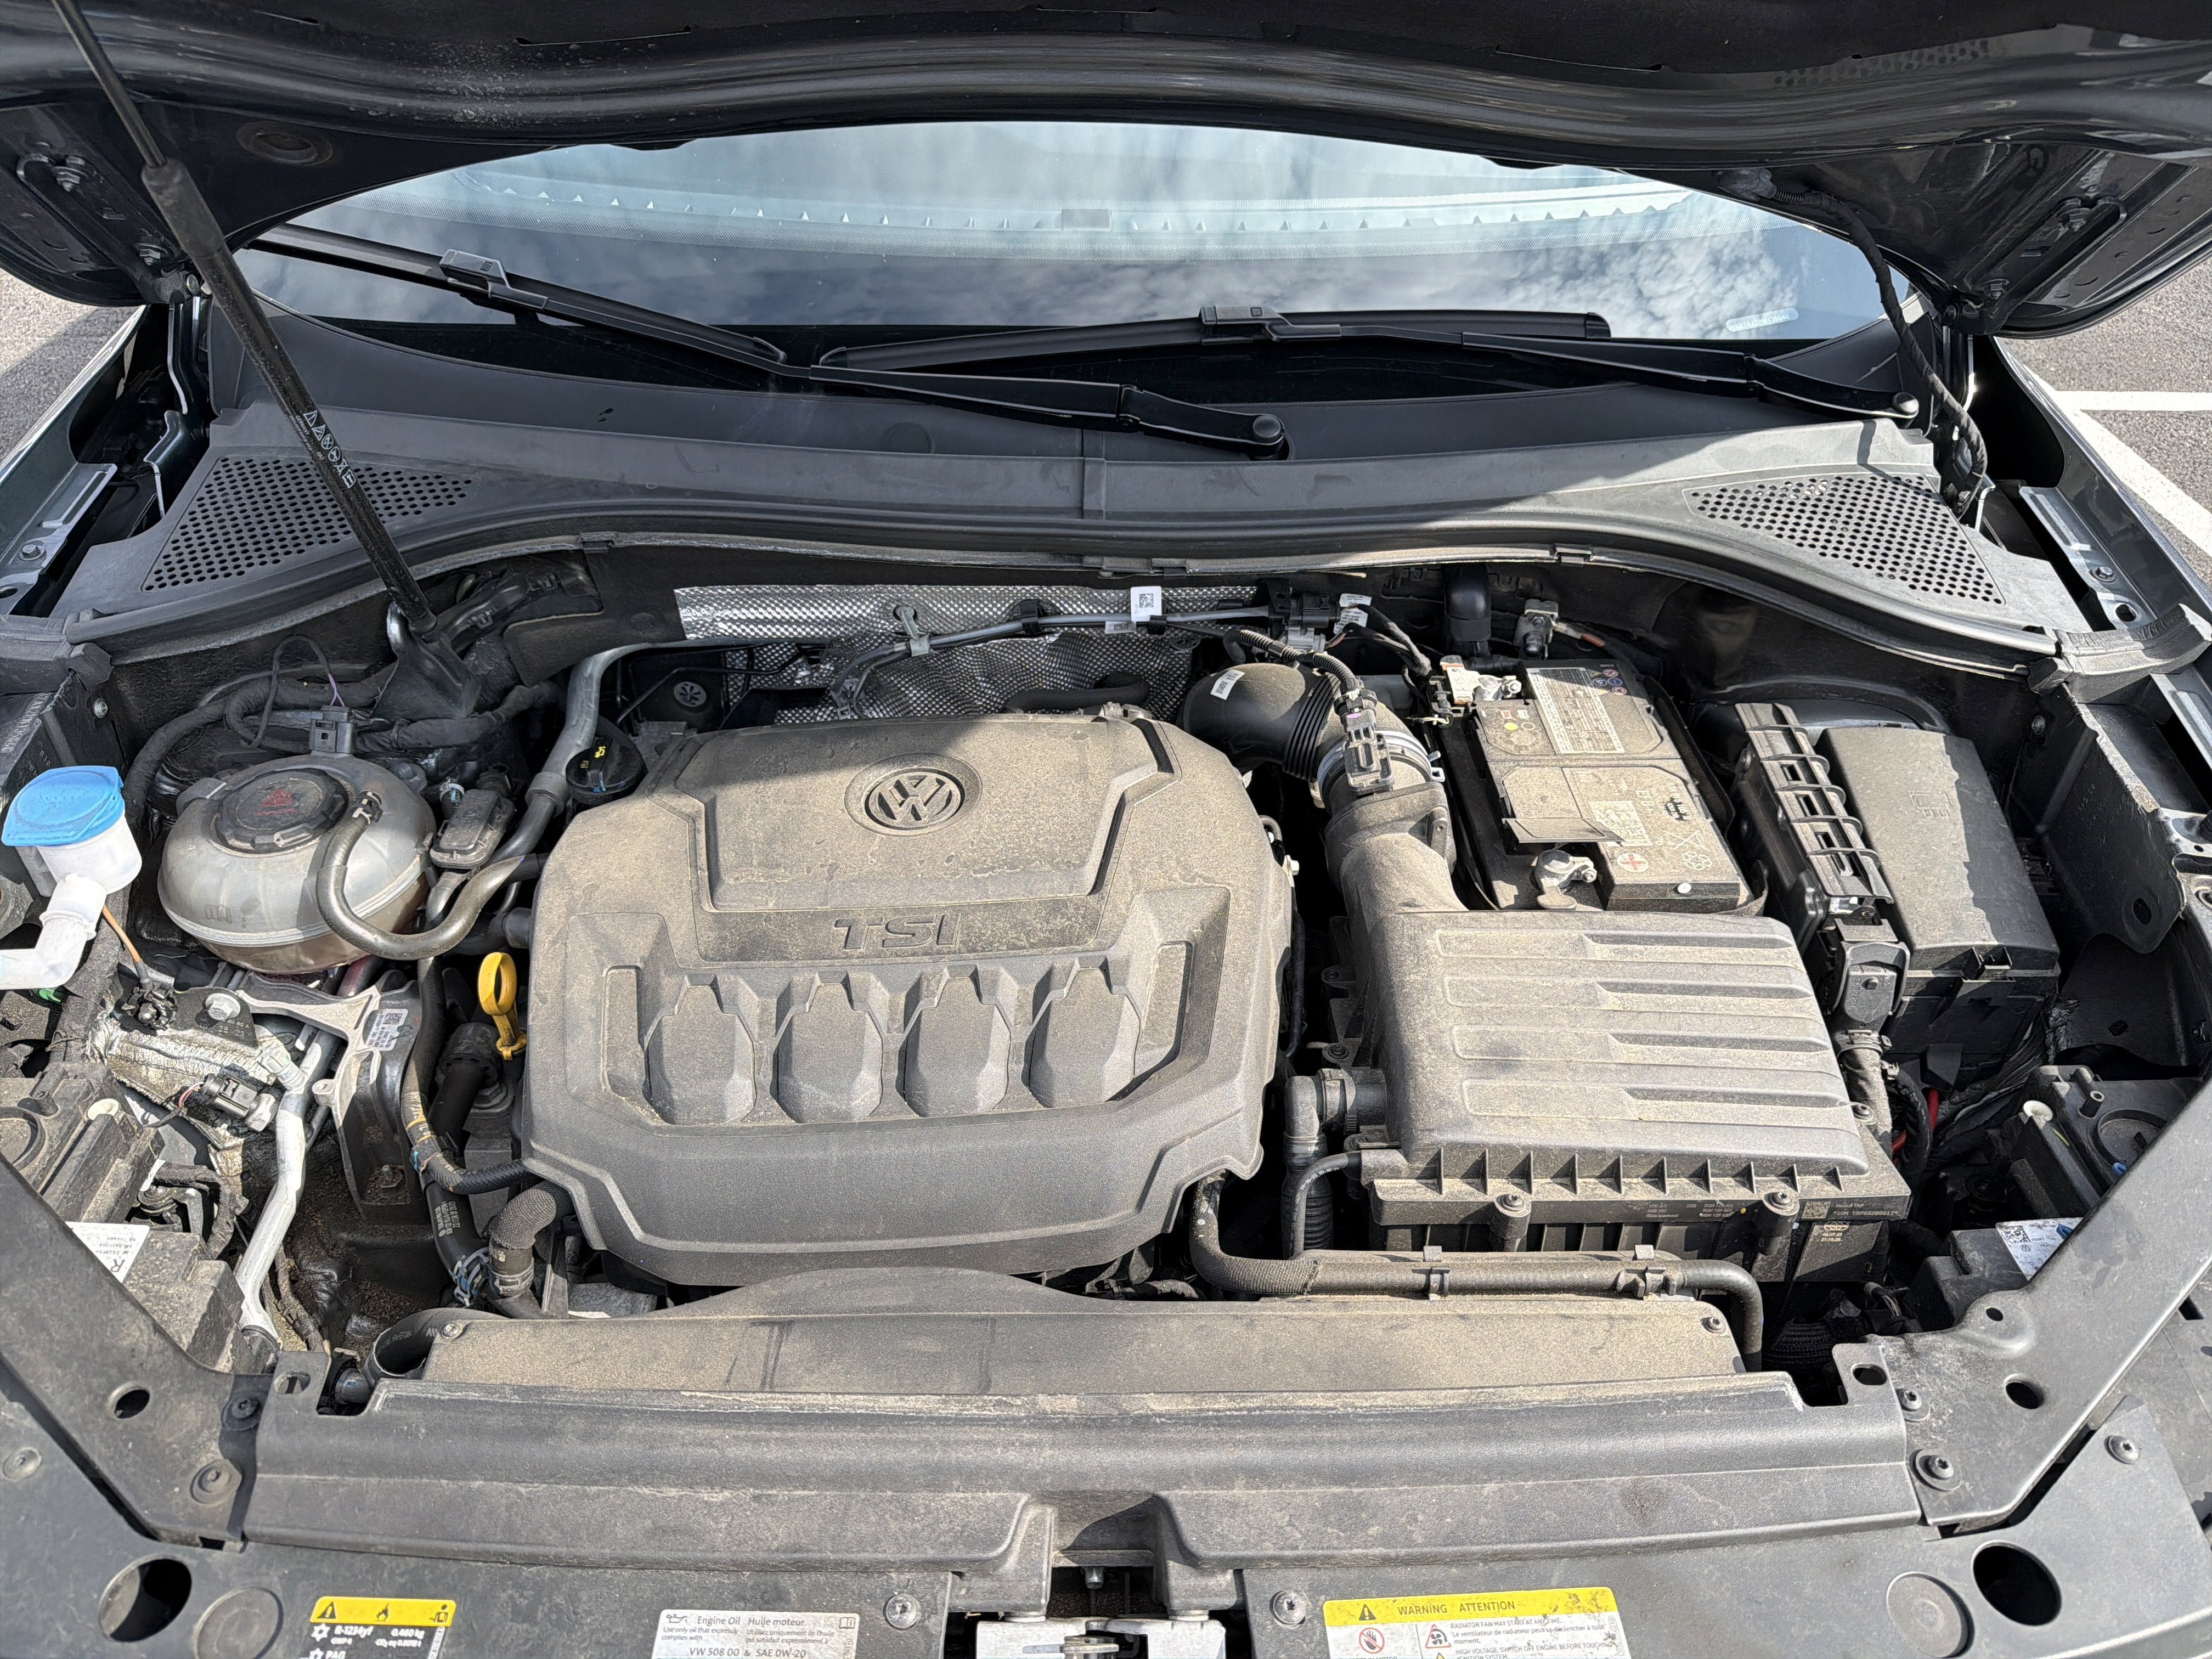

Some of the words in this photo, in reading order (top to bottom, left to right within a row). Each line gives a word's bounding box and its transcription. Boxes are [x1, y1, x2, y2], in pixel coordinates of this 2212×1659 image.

[867, 770, 962, 829] VW
[834, 913, 961, 951] TSI
[110, 1259, 126, 1273] R
[1397, 1604, 1447, 1615] WARNING
[1459, 1601, 1515, 1612] ATTENTION
[697, 1616, 726, 1627] Engine
[728, 1617, 741, 1625] Oil
[748, 1617, 771, 1627] Huile
[773, 1618, 805, 1626] moteur
[334, 1625, 374, 1638] R-1234yf
[415, 1629, 425, 1639] kg
[325, 1651, 346, 1659] PAG
[690, 1647, 706, 1656] VW
[707, 1647, 725, 1656] 508
[756, 1649, 774, 1657] SAE
[775, 1648, 806, 1658] 0W-20
